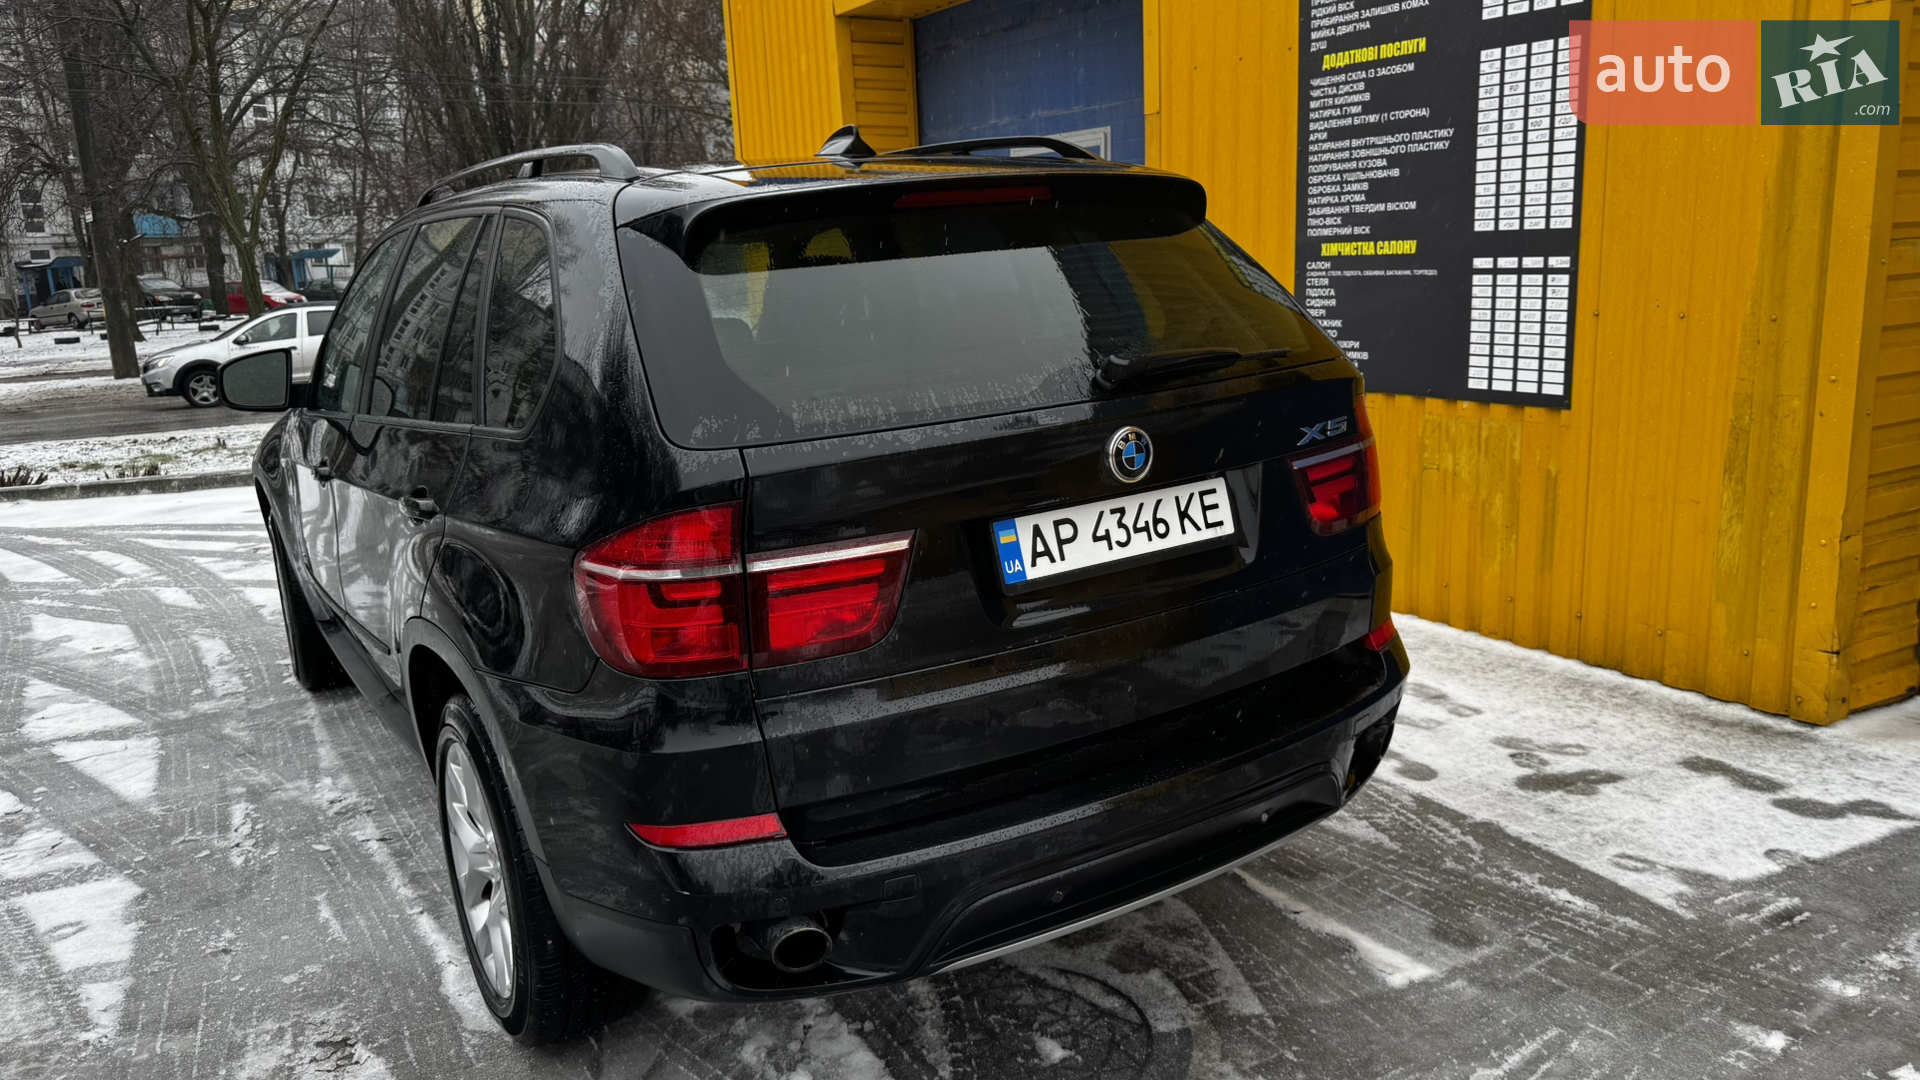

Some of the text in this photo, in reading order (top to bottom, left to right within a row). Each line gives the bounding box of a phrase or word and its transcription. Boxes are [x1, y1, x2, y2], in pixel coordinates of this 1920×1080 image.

[1311, 3, 1337, 18] РІДКИЙ
[1338, 1, 1355, 12] ВІСК
[1311, 0, 1430, 29] ПРИБИРАННЯ ЗАЛИШКІВ КОМАХ
[1311, 21, 1371, 40] МИЙКА ДВИГУНА
[1310, 40, 1327, 52] ДУШ
[1322, 37, 1427, 71] ДОДАТКОВІ ПОСЛУГИ
[1310, 62, 1415, 87] ЧИЩЕННЯ СКЛА ІЗ ЗАСОБОМ
[1310, 82, 1365, 98] ЧИСТКА ДИСКІВ
[1310, 92, 1371, 109] МИТТЯ КИЛИМКІВ
[1310, 105, 1362, 120] НАТИРКА ГУМИ
[1310, 107, 1430, 131] ВИДАЛЕННЯ БІТУМУ (1 СТОРОНА)
[1309, 132, 1327, 141] АРКИ
[1309, 128, 1454, 152] НАТИРАННЯ ВНУТРІШНЬОГО ПЛАСТИКУ
[1309, 140, 1450, 163] НАТИРАННЯ ЗОВНІШНЬОГО ПЛАСТИКУ
[1358, 158, 1387, 169] КУЗОВА
[1308, 168, 1400, 184] ОБРОБКА УЩІЛЬНЮВАЧІВ
[1308, 182, 1369, 195] ОБРОБКА ЗАМКІВ
[1308, 193, 1366, 205] НАТИРКА ХРОМА
[1307, 201, 1417, 216] ЗАБИВАННЯ ТВЕРДИМ ВІСКОМ
[1307, 216, 1342, 226] ПІНО-ВІСК
[1353, 225, 1371, 235] ВІСК
[1321, 239, 1417, 256] ХІМЧИСТКА САЛОНУ
[1306, 261, 1331, 270] САЛОН
[1306, 278, 1329, 286] СТЕЛЯ
[1306, 288, 1335, 297] ПІДЛОГА
[1305, 298, 1336, 307] СИДІННЯ
[1296, 415, 1348, 446] X5
[1117, 433, 1148, 450] BMW
[1030, 488, 1224, 568] AP 4346 KE
[1004, 558, 1023, 574] UA
